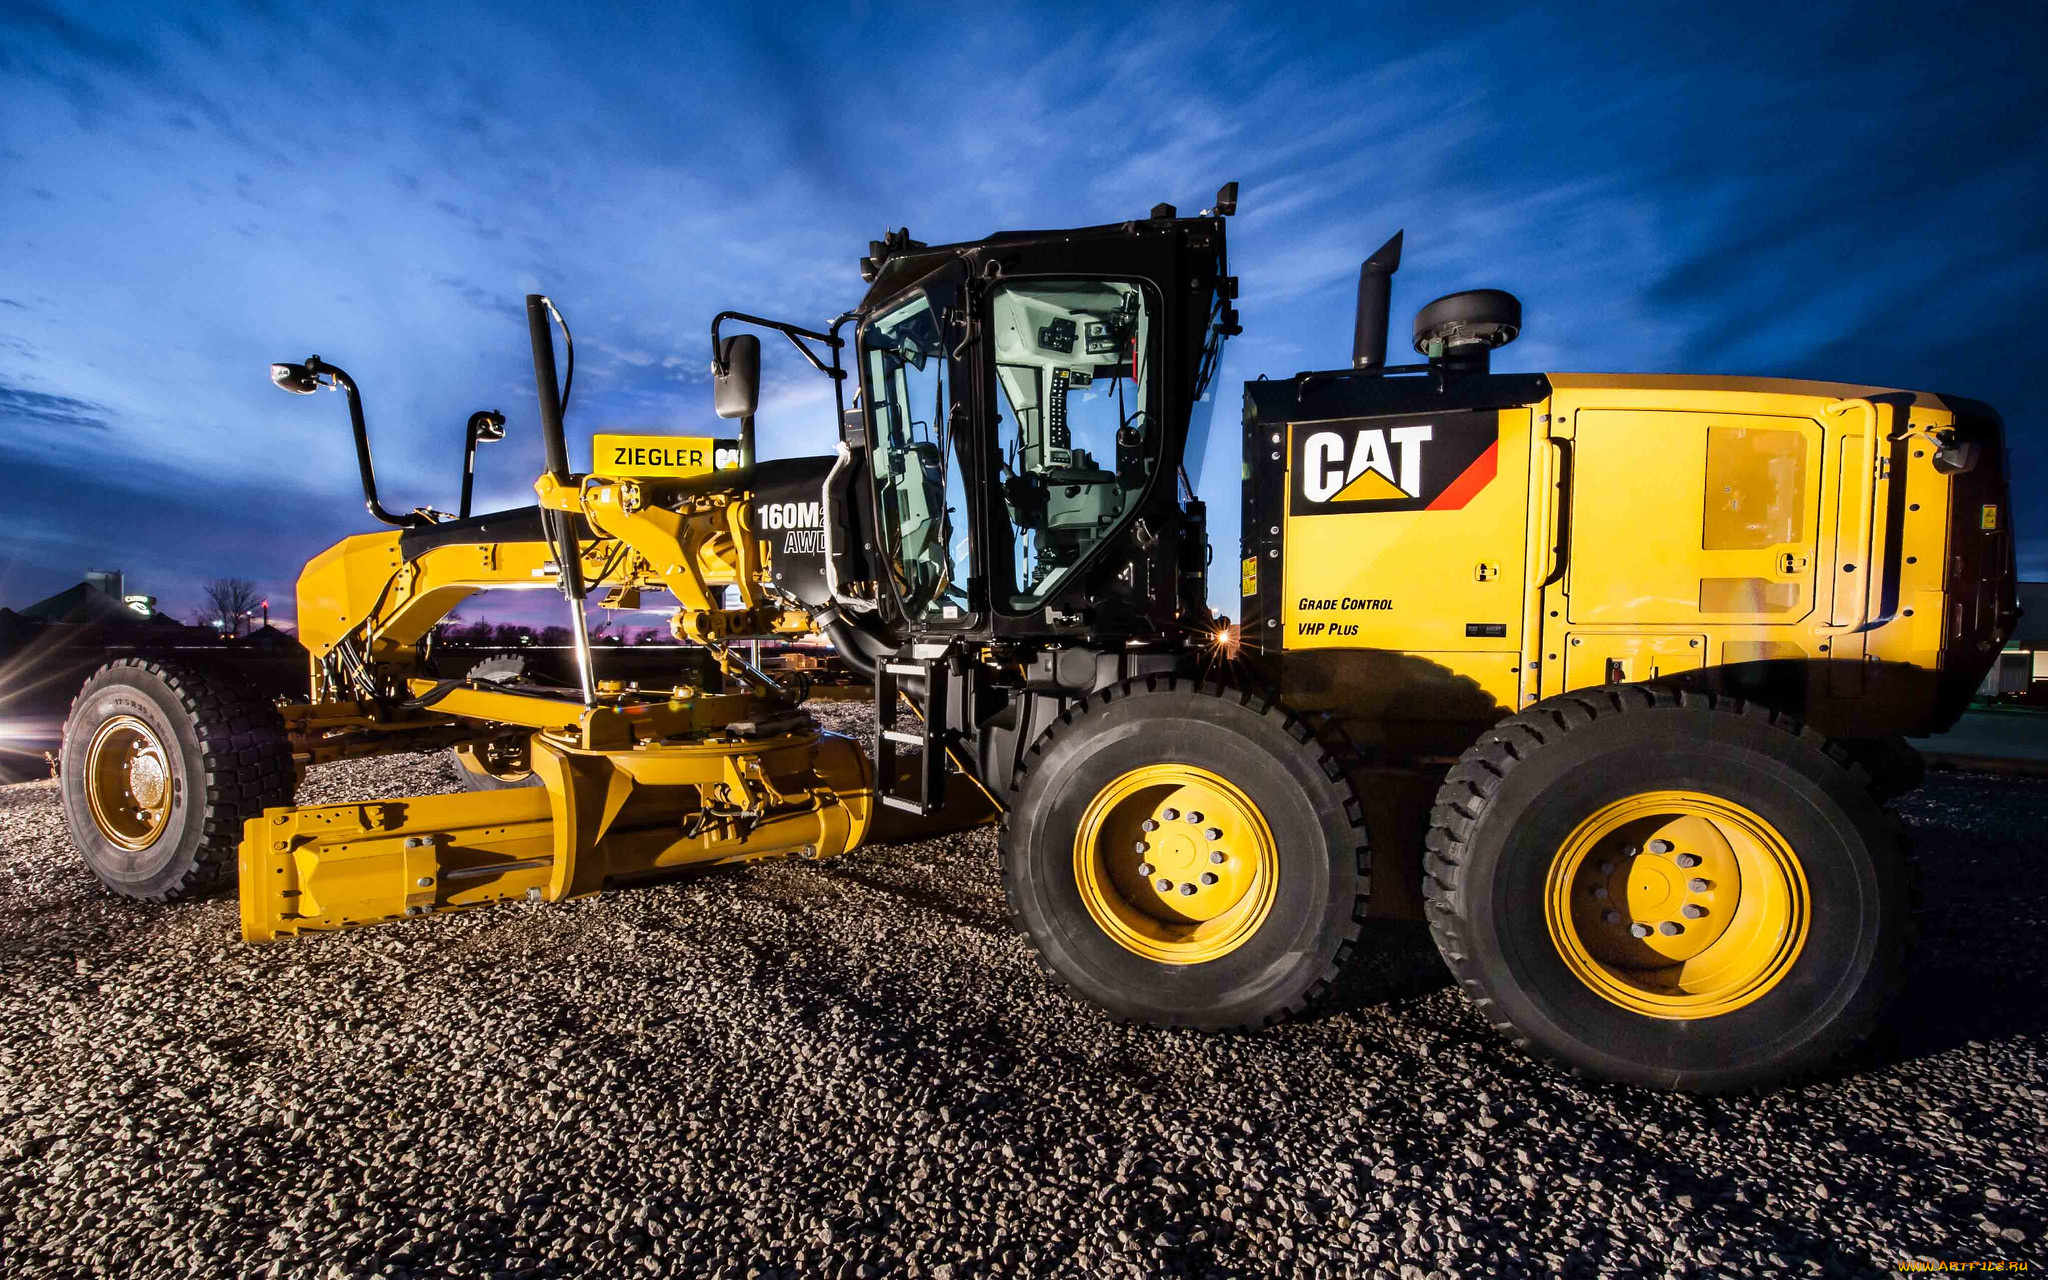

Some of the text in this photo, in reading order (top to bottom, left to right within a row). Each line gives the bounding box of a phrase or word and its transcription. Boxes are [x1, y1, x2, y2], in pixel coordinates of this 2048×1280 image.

[614, 447, 703, 467] ZIEGLER
[1304, 425, 1432, 503] CAT
[1298, 597, 1393, 610] GRADE CONTROL
[1298, 623, 1359, 635] VHP PLUS
